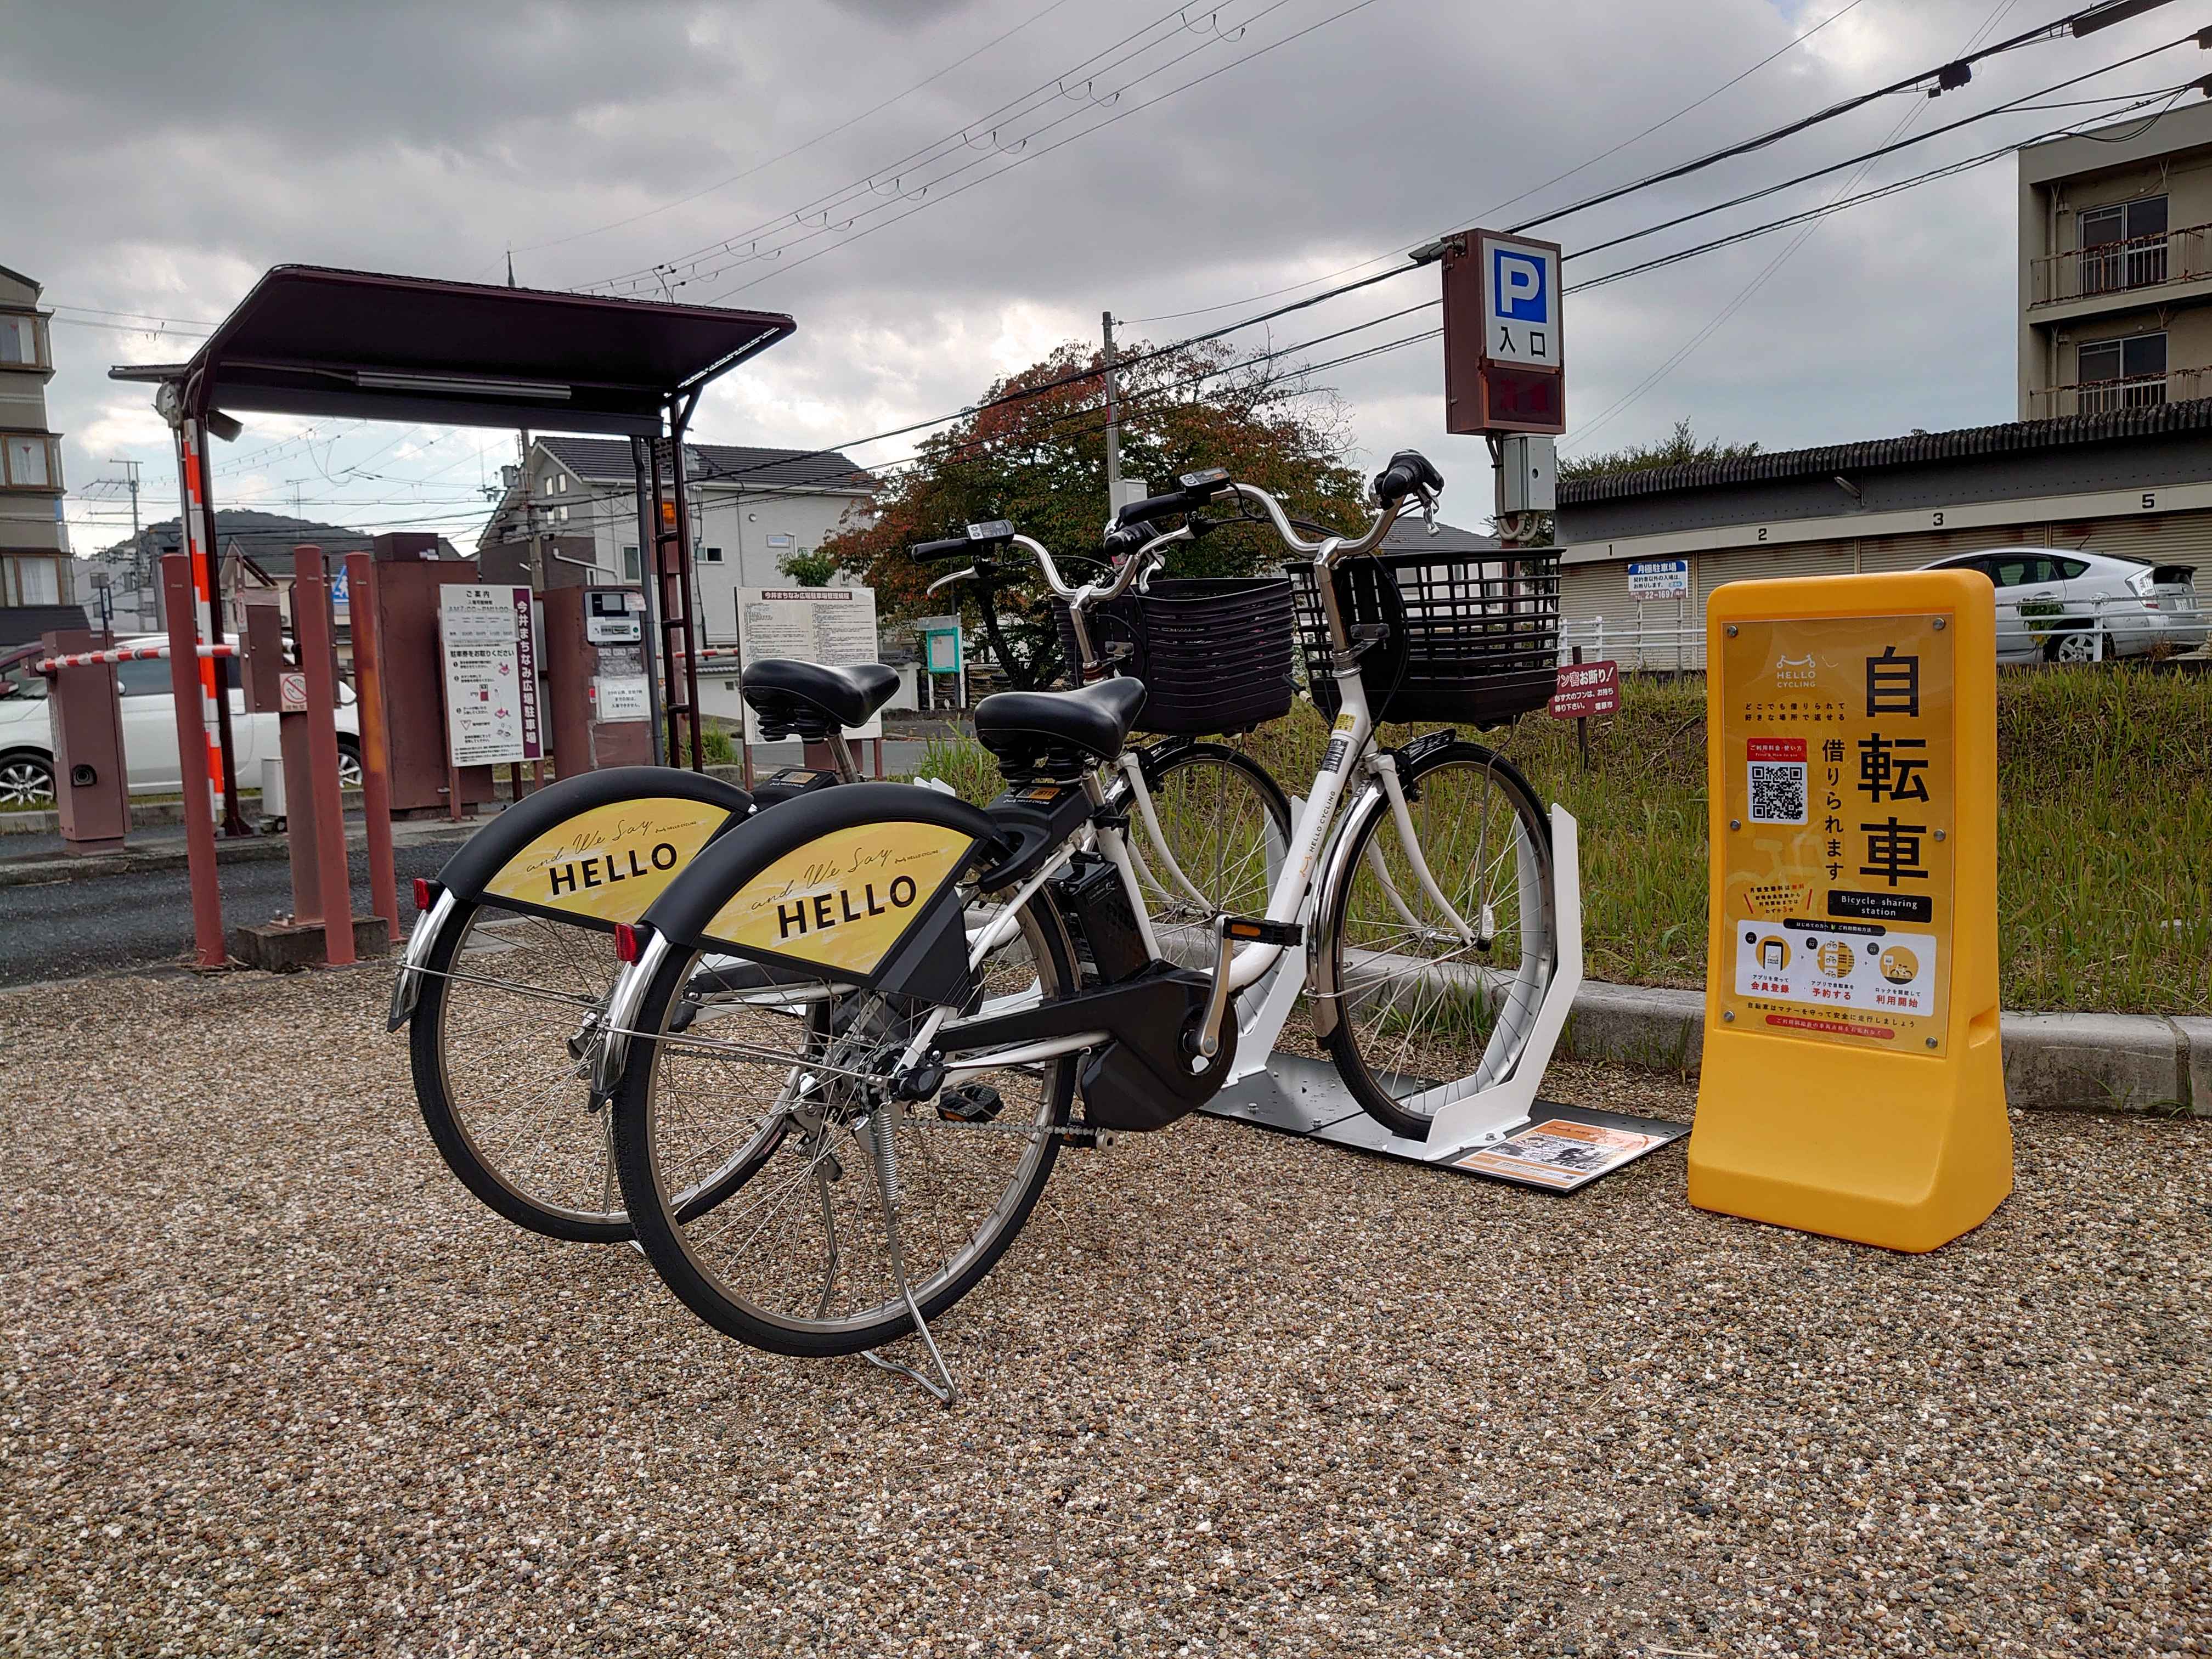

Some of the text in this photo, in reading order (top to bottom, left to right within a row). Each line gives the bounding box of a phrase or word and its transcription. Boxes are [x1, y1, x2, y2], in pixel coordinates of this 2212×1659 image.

[1500, 256, 1539, 313] P
[1499, 326, 1546, 358] 入口
[2142, 494, 2155, 509] 5
[1933, 512, 1944, 526] 3
[1758, 528, 1767, 541] 2
[1609, 544, 1612, 556] 1
[1638, 562, 1677, 574] 月極駐車場
[1645, 590, 1673, 599] 22-1697
[517, 600, 537, 744] 今井まちなみ広場駐車場
[1777, 671, 1816, 679] HELLO
[1858, 646, 1930, 887] 自転車
[1822, 739, 1846, 881] 借りられます
[1310, 791, 1335, 853] HELLO CYCLING
[526, 820, 653, 873] and We Say
[549, 843, 677, 896] HELLO
[751, 847, 893, 911] and We Say
[777, 875, 917, 938] HELLO
[1841, 895, 1917, 910] Bicycle sharing
[1861, 907, 1896, 916] station
[1751, 981, 1790, 994] 会員登録
[1812, 988, 1851, 1001] 予約する
[1876, 995, 1918, 1008] 利用開始
